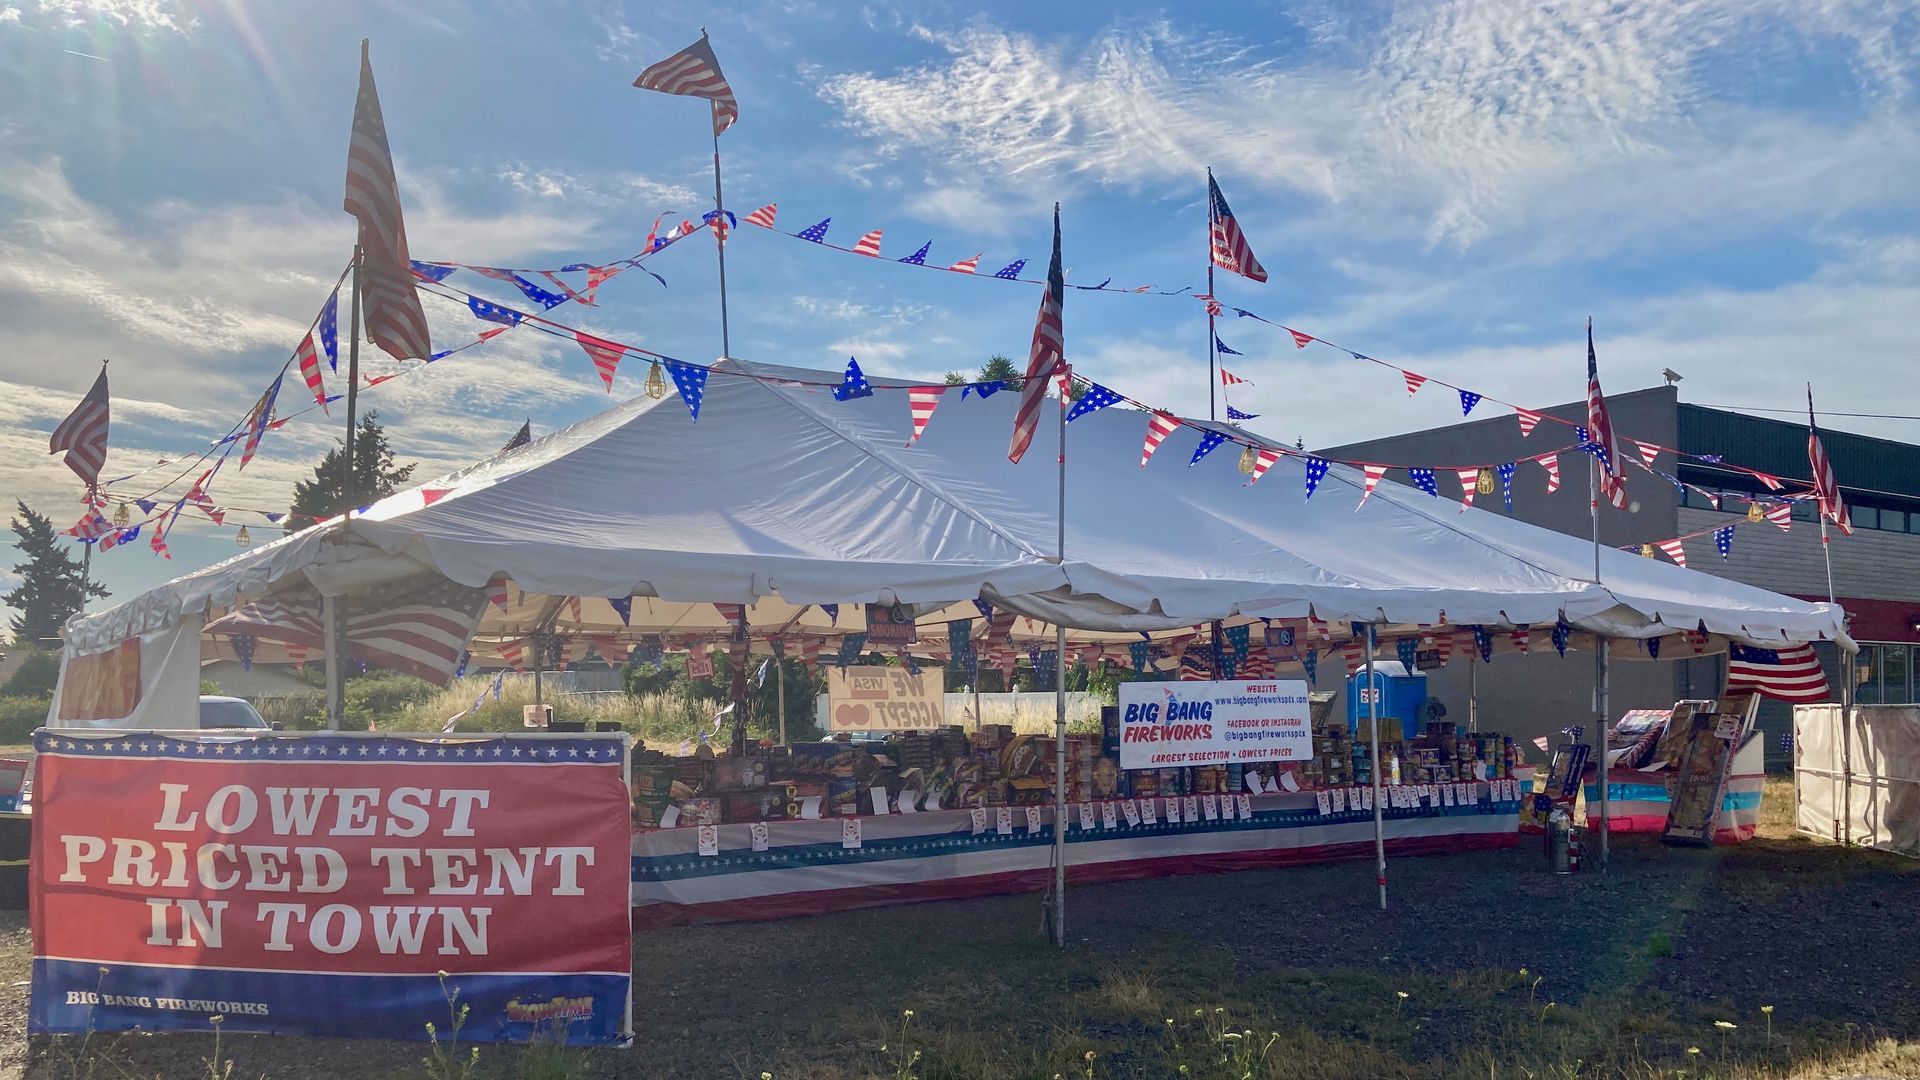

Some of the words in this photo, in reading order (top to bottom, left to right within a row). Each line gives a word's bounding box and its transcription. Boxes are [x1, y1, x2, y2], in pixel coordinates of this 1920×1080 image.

[870, 623, 913, 638] SMOKING
[1246, 685, 1277, 693] WEBSITE
[1124, 702, 1160, 723] BIG
[1166, 701, 1213, 721] BANG
[1227, 720, 1258, 728] FACEBOOK
[1261, 719, 1270, 727] OR
[1271, 718, 1302, 727] INSTAGRAM
[1123, 724, 1213, 743] FIREWORKS
[1151, 753, 1186, 763] LARGEST
[1188, 750, 1230, 761] SELECTION
[1238, 749, 1267, 758] LOWEST
[1270, 748, 1293, 757] PRICES
[154, 783, 490, 838] LOWEST
[59, 835, 348, 893] PRICED
[370, 846, 595, 896] TENT
[146, 898, 229, 948] IN
[256, 902, 492, 955] TOWN
[66, 991, 99, 1005] BIG
[102, 994, 152, 1008] BANG
[155, 997, 269, 1016] FIREWORKS
